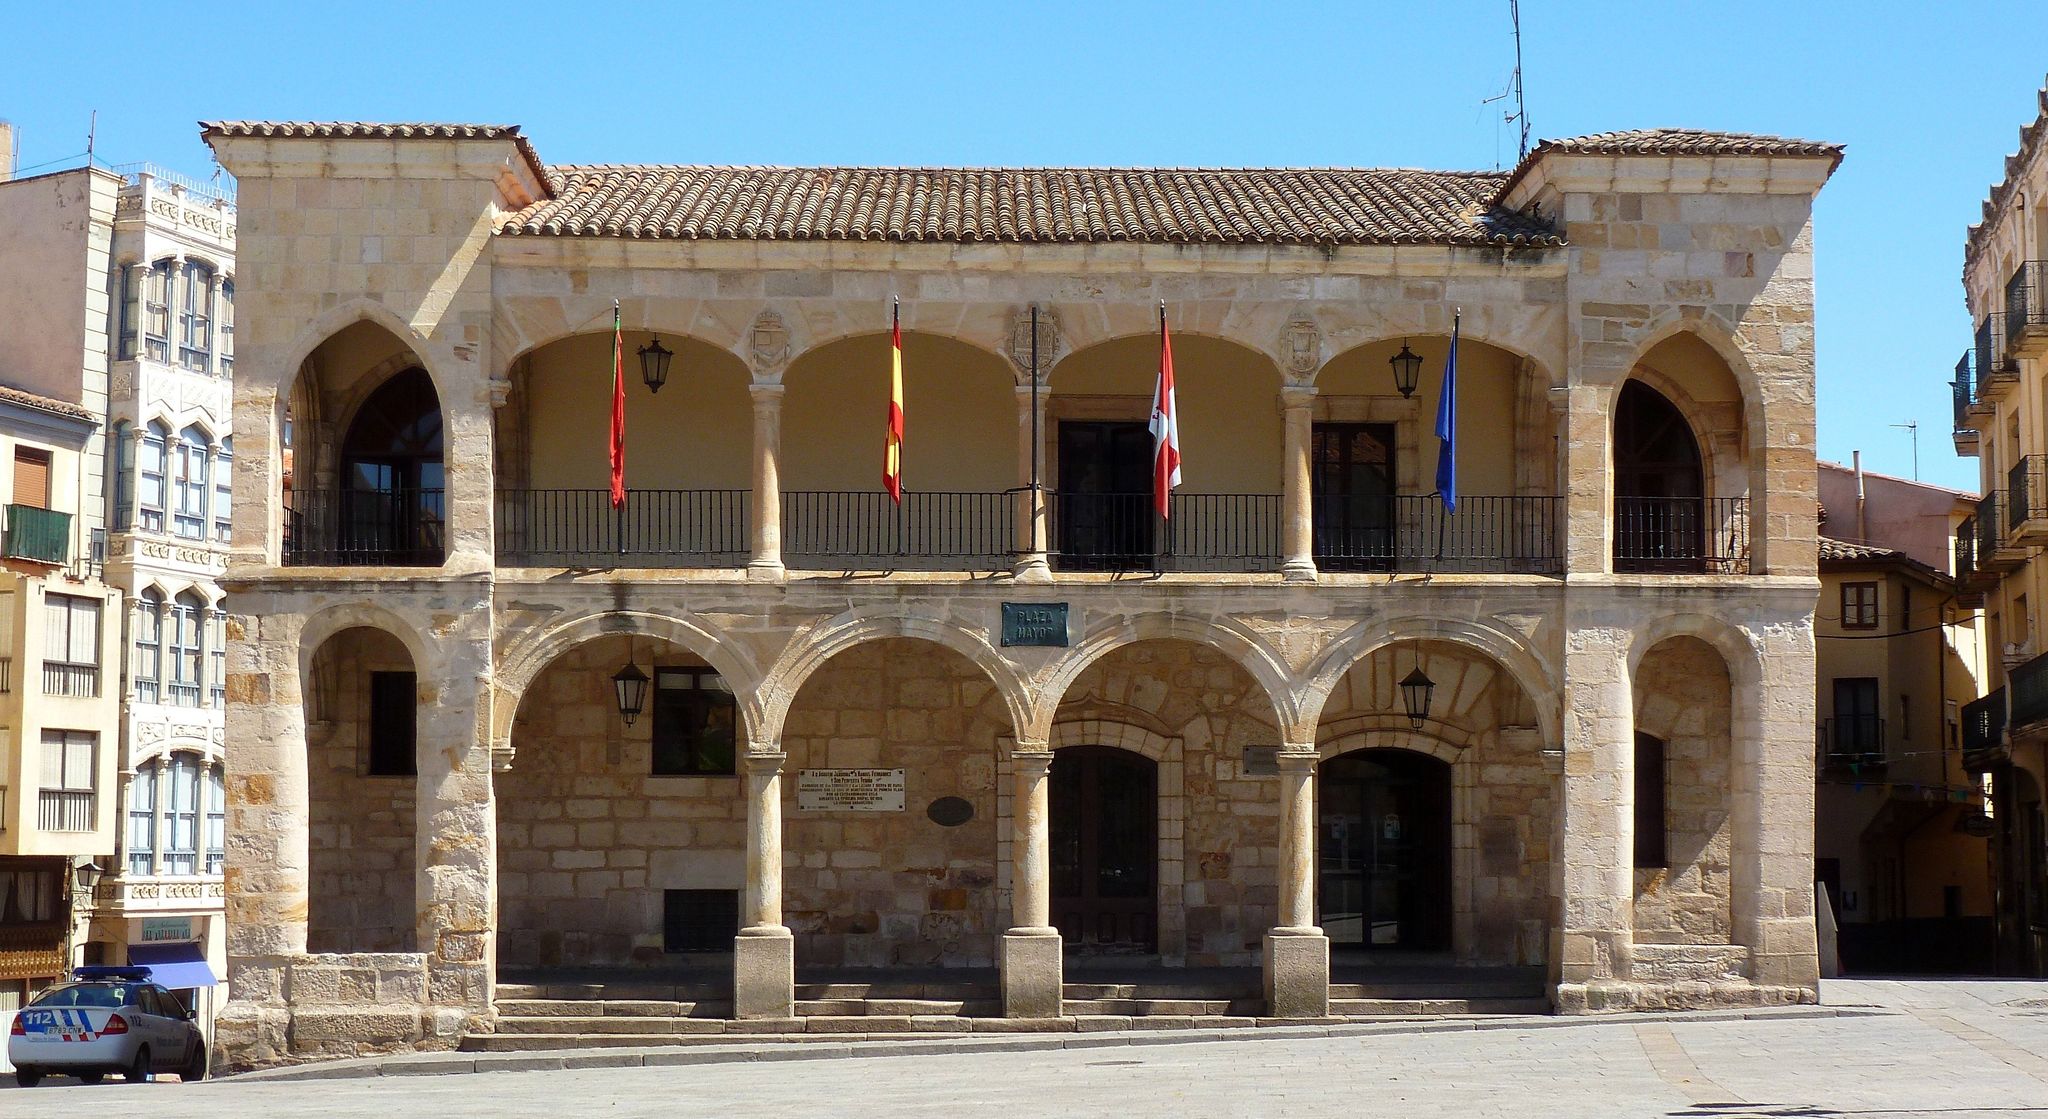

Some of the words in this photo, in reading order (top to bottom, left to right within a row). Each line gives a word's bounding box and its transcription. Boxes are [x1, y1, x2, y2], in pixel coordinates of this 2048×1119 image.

[1017, 610, 1053, 624] PLAZA
[26, 1012, 52, 1024] 112
[129, 1015, 143, 1027] 112
